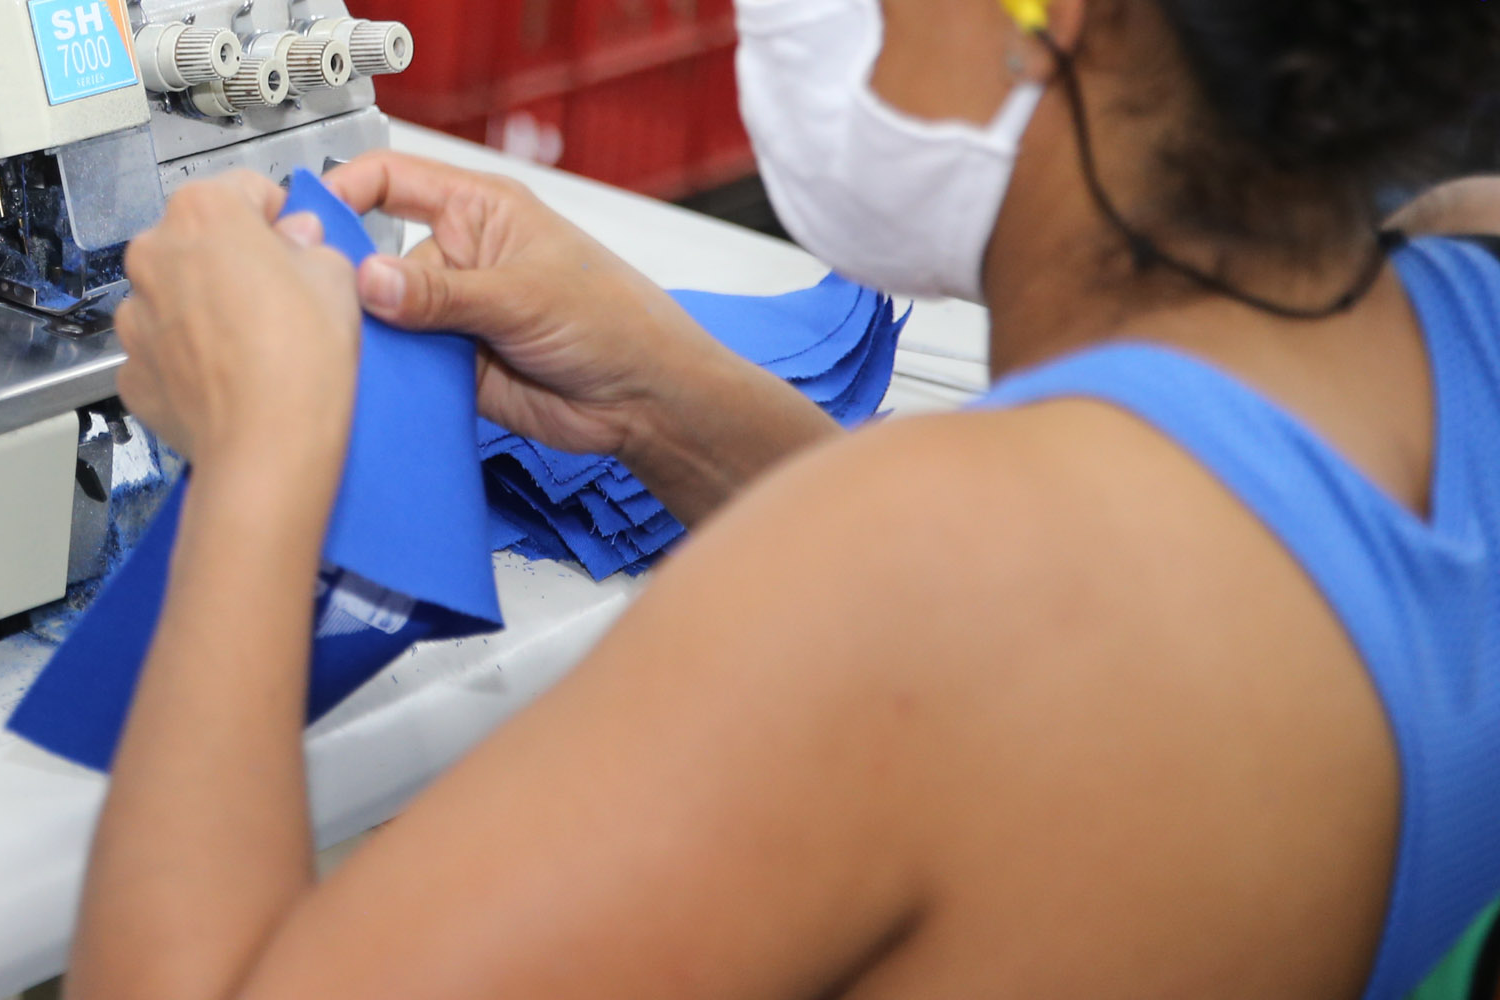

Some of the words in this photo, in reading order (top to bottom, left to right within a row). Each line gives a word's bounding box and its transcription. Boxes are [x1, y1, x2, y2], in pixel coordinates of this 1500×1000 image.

[51, 2, 104, 40] SH
[57, 36, 111, 78] 7000
[76, 74, 105, 88] SERIES
